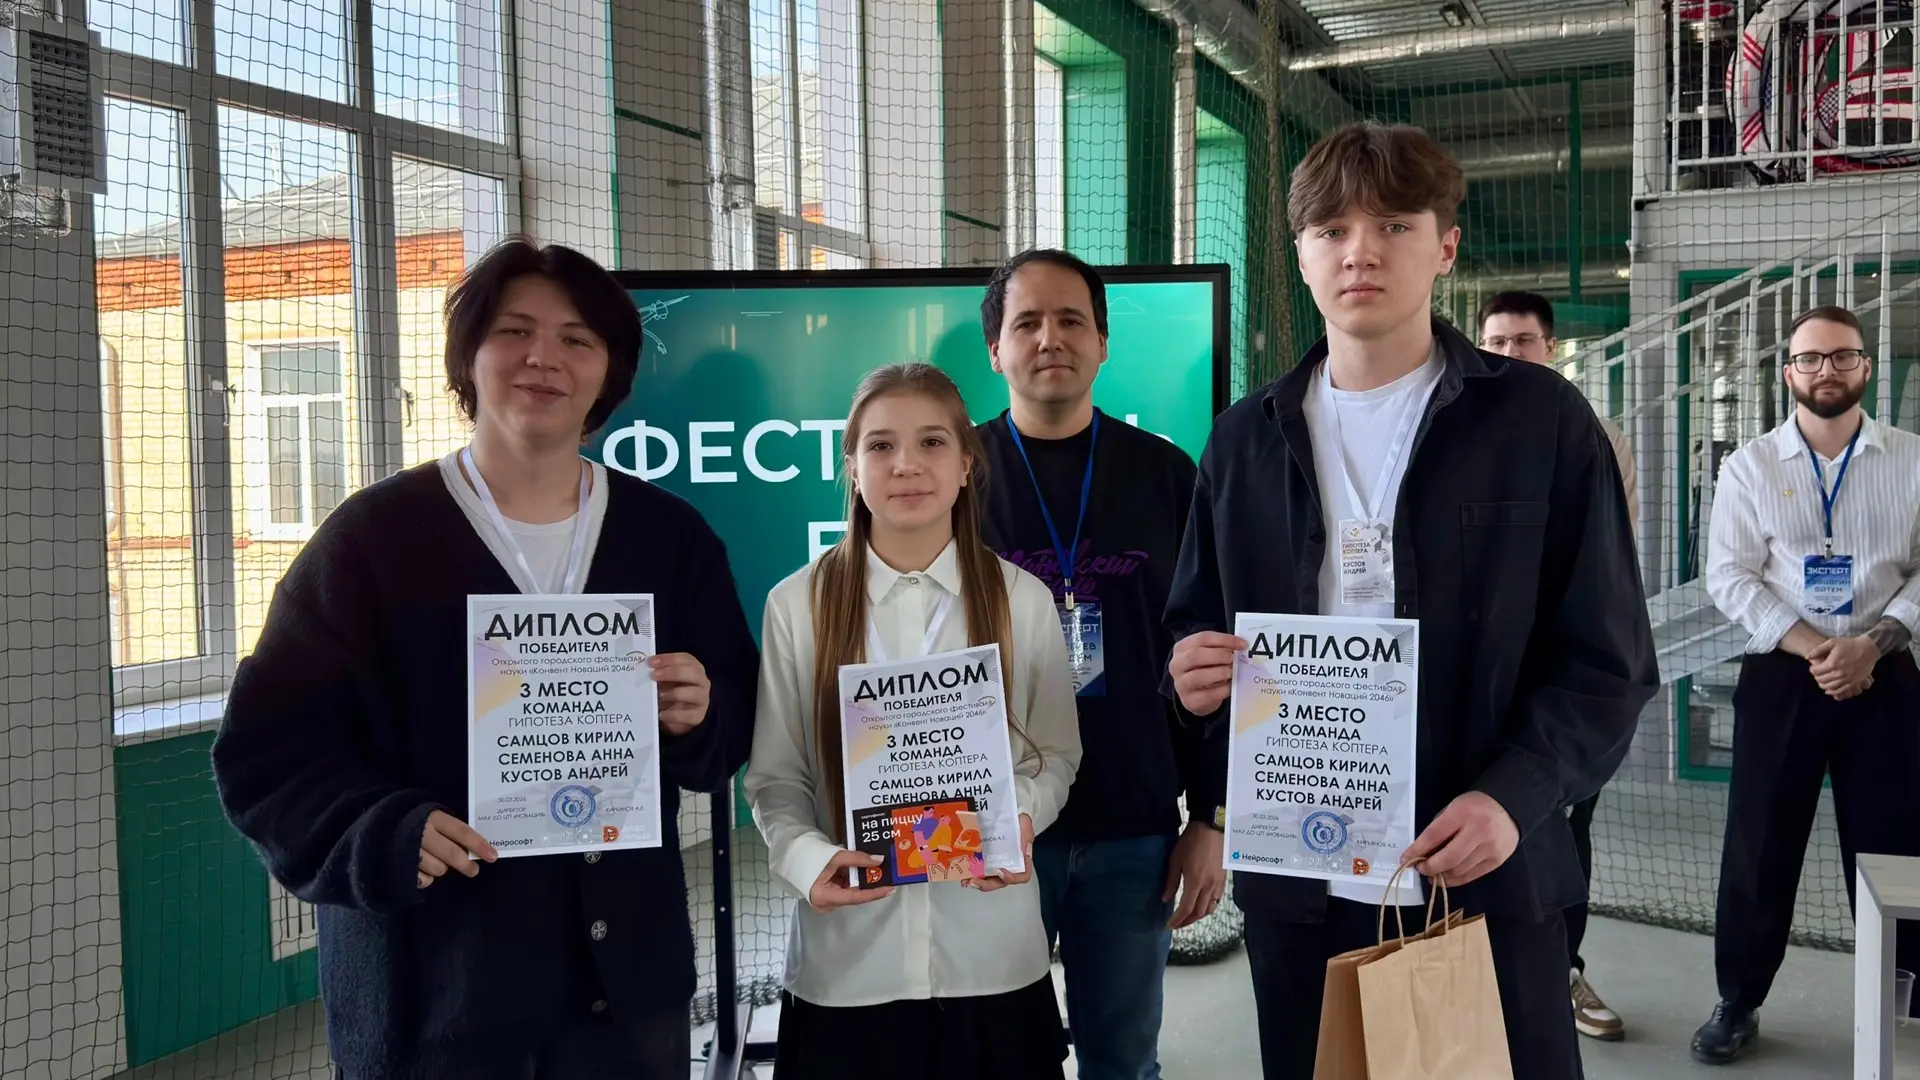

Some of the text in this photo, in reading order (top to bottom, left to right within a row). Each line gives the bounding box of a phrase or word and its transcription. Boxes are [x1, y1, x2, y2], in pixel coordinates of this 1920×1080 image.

[1343, 567, 1367, 575] АНДРЕЙ
[1806, 567, 1850, 575] ЭКСПЕРТ
[484, 612, 640, 641] ДИПЛОМ
[1061, 623, 1099, 634] СПЕРТ
[519, 641, 609, 655] ПОБЕДИТЕЛЯ
[1248, 632, 1401, 663] ДИПЛОМ
[491, 654, 643, 667] Открытого городского фестиваля
[500, 664, 635, 677] науки «Конвент Новаций 2046»
[1279, 663, 1368, 679] ПОБЕДИТЕЛЯ
[520, 680, 609, 698] 3 МЕСТО
[853, 661, 989, 703] ДИПЛОМ
[1253, 676, 1403, 693] Открытого городского фестиваля
[884, 691, 963, 711] ПОБЕДИТЕЛЯ
[1260, 688, 1394, 702] науки «Конвент Новаций 2046»
[523, 700, 605, 715] КОМАНДА
[861, 700, 993, 724] Открытого городского фестиваля
[1278, 703, 1366, 724] 3 МЕСТО
[508, 713, 633, 728] ГИПОТЕЗА КОПТЕРА
[868, 709, 987, 731] науки «Конвент Новаций 2046»
[497, 730, 635, 748] САМЦОВ КИРИЛЛ
[886, 726, 965, 749] 3 МЕСТО
[1280, 723, 1361, 741] КОМАНДА
[890, 744, 963, 763] КОМАНДА
[1266, 737, 1389, 755] ГИПОТЕЗА КОПТЕРА
[498, 747, 635, 766] СЕМЕНОВА АННА
[878, 753, 989, 774] ГИПОТЕЗА КОПТЕРА
[1254, 753, 1391, 776] САМЦОВ КИРИЛЛ
[501, 763, 629, 783] КУСТОВ АНДРЕЙ
[869, 767, 993, 791] САМЦОВ КИРИЛЛ
[1254, 771, 1389, 794] СЕМЕНОВА АННА
[871, 783, 993, 805] СЕМЕНОВА АННА
[1256, 788, 1382, 811] КУСТОВ АНДРЕЙ
[861, 813, 923, 830] на пиццу
[489, 838, 534, 847] Нейрософт
[862, 829, 901, 843] 25 см
[1241, 853, 1285, 865] Нейрософт
